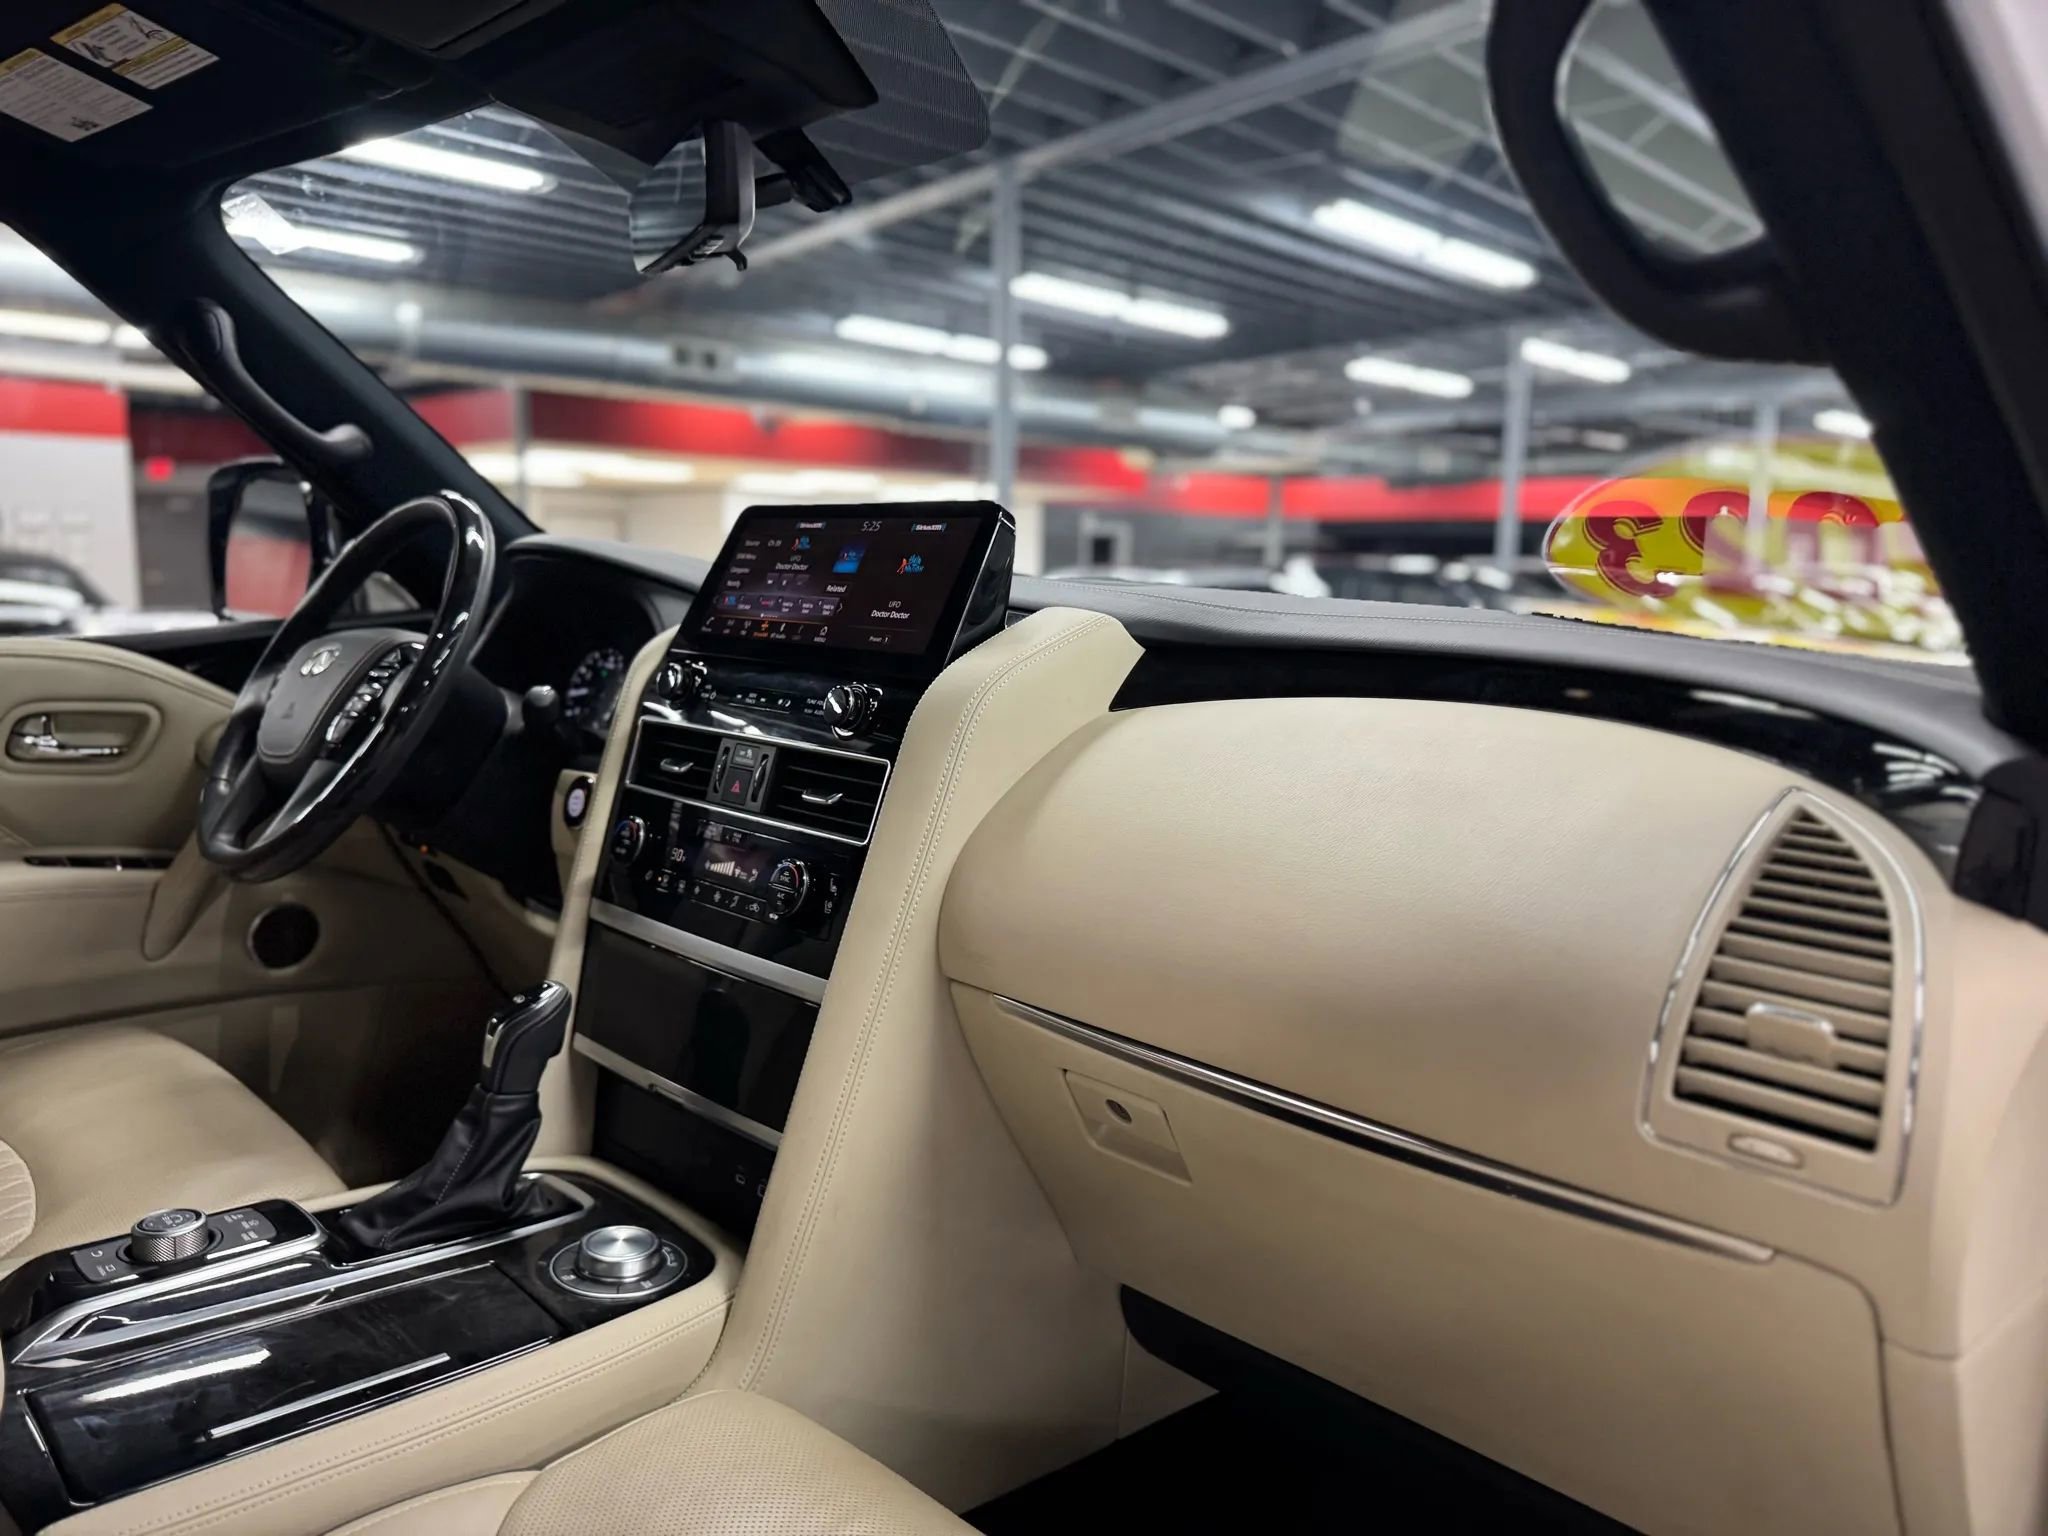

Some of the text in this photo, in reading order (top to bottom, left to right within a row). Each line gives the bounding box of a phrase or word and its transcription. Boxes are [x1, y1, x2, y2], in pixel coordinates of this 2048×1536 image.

[861, 521, 882, 531] 5:25
[826, 585, 848, 593] Related
[871, 609, 911, 619] Doctor Doctor
